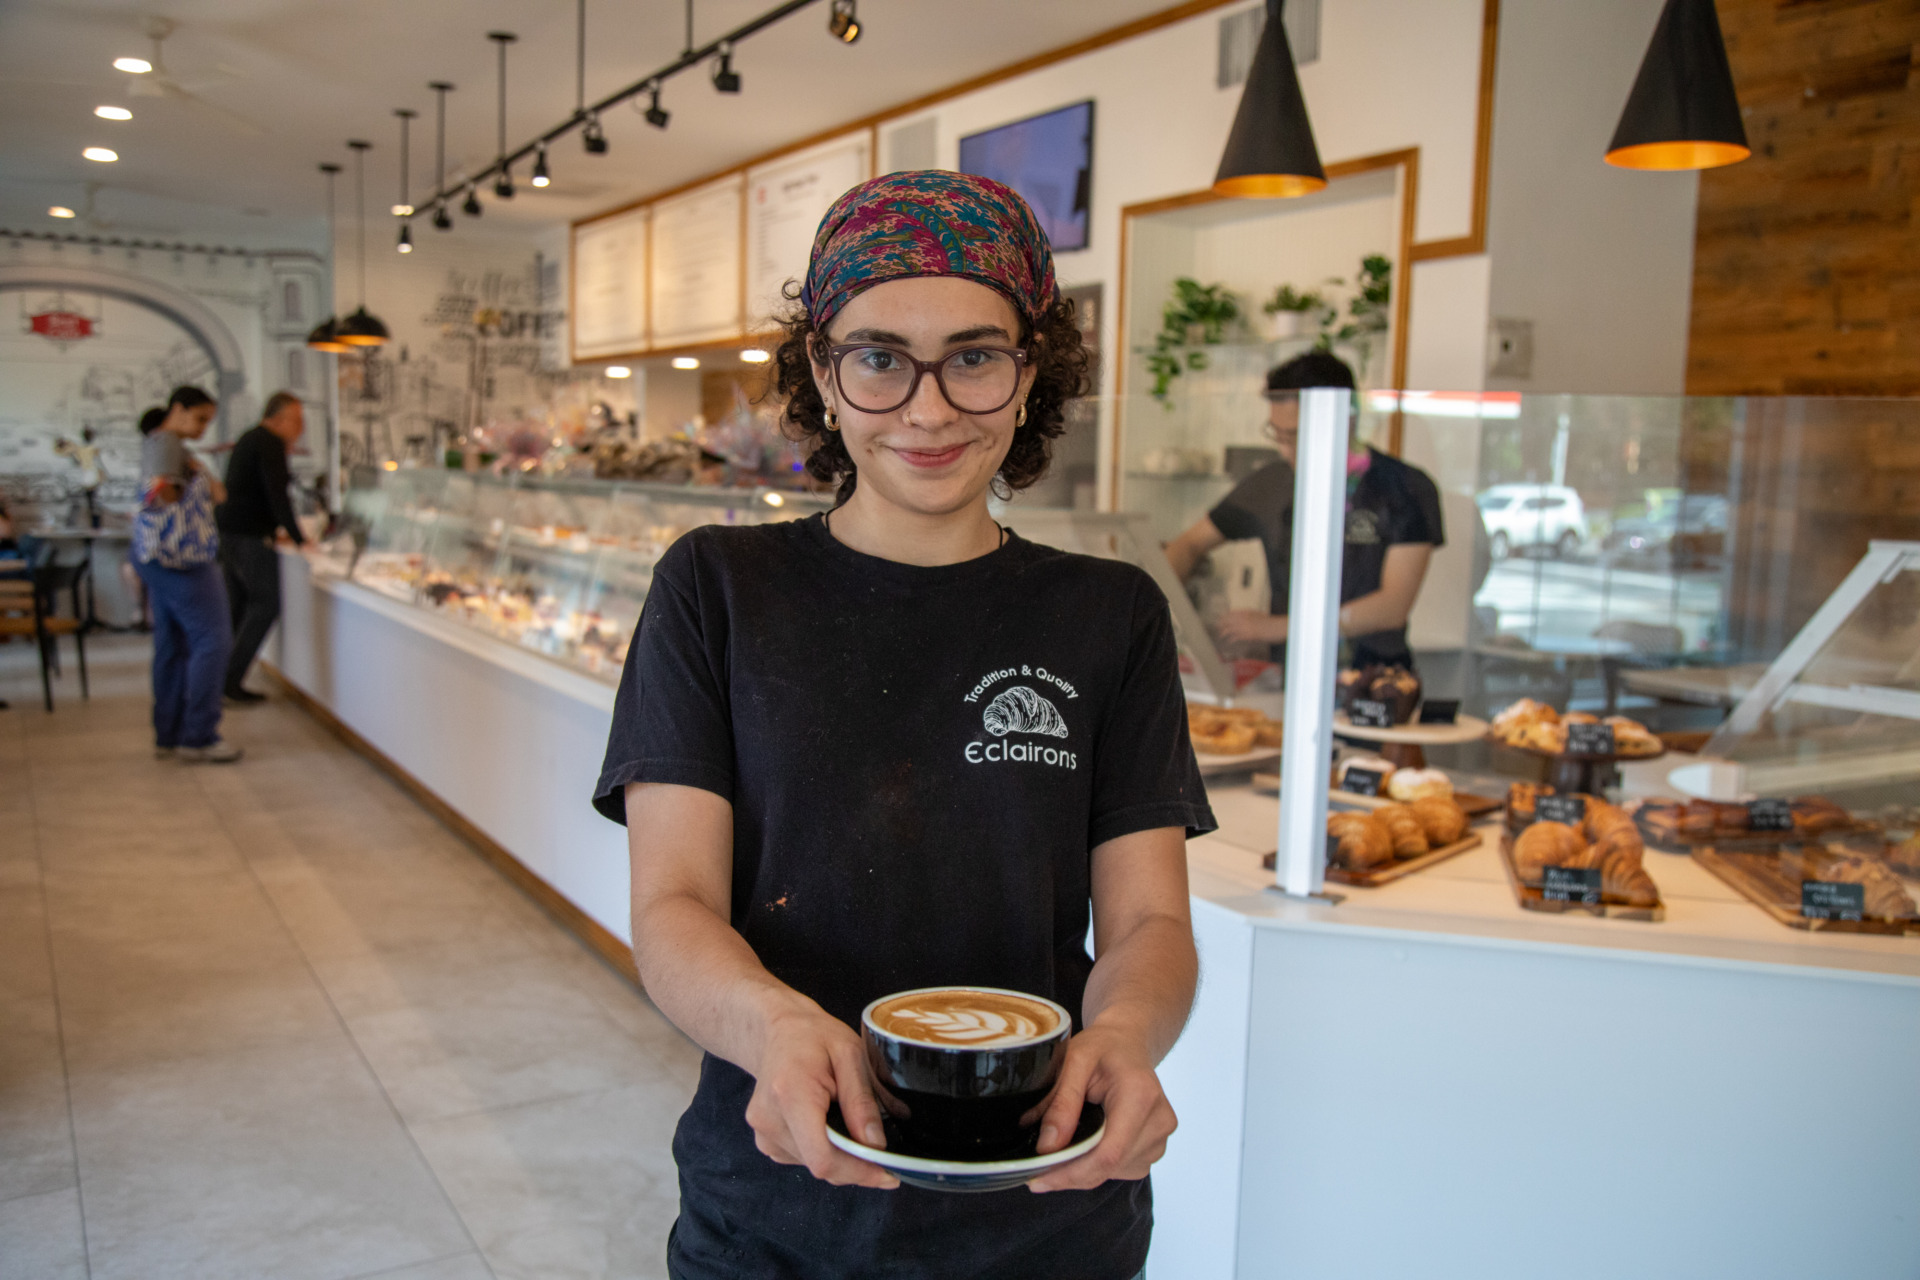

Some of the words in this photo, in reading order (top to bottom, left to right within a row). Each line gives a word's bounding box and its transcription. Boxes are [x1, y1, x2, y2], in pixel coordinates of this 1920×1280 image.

[964, 668, 1017, 703] Tradition
[1021, 664, 1032, 676] &
[1035, 667, 1079, 699] Quality
[964, 739, 1077, 770] Eclairons
